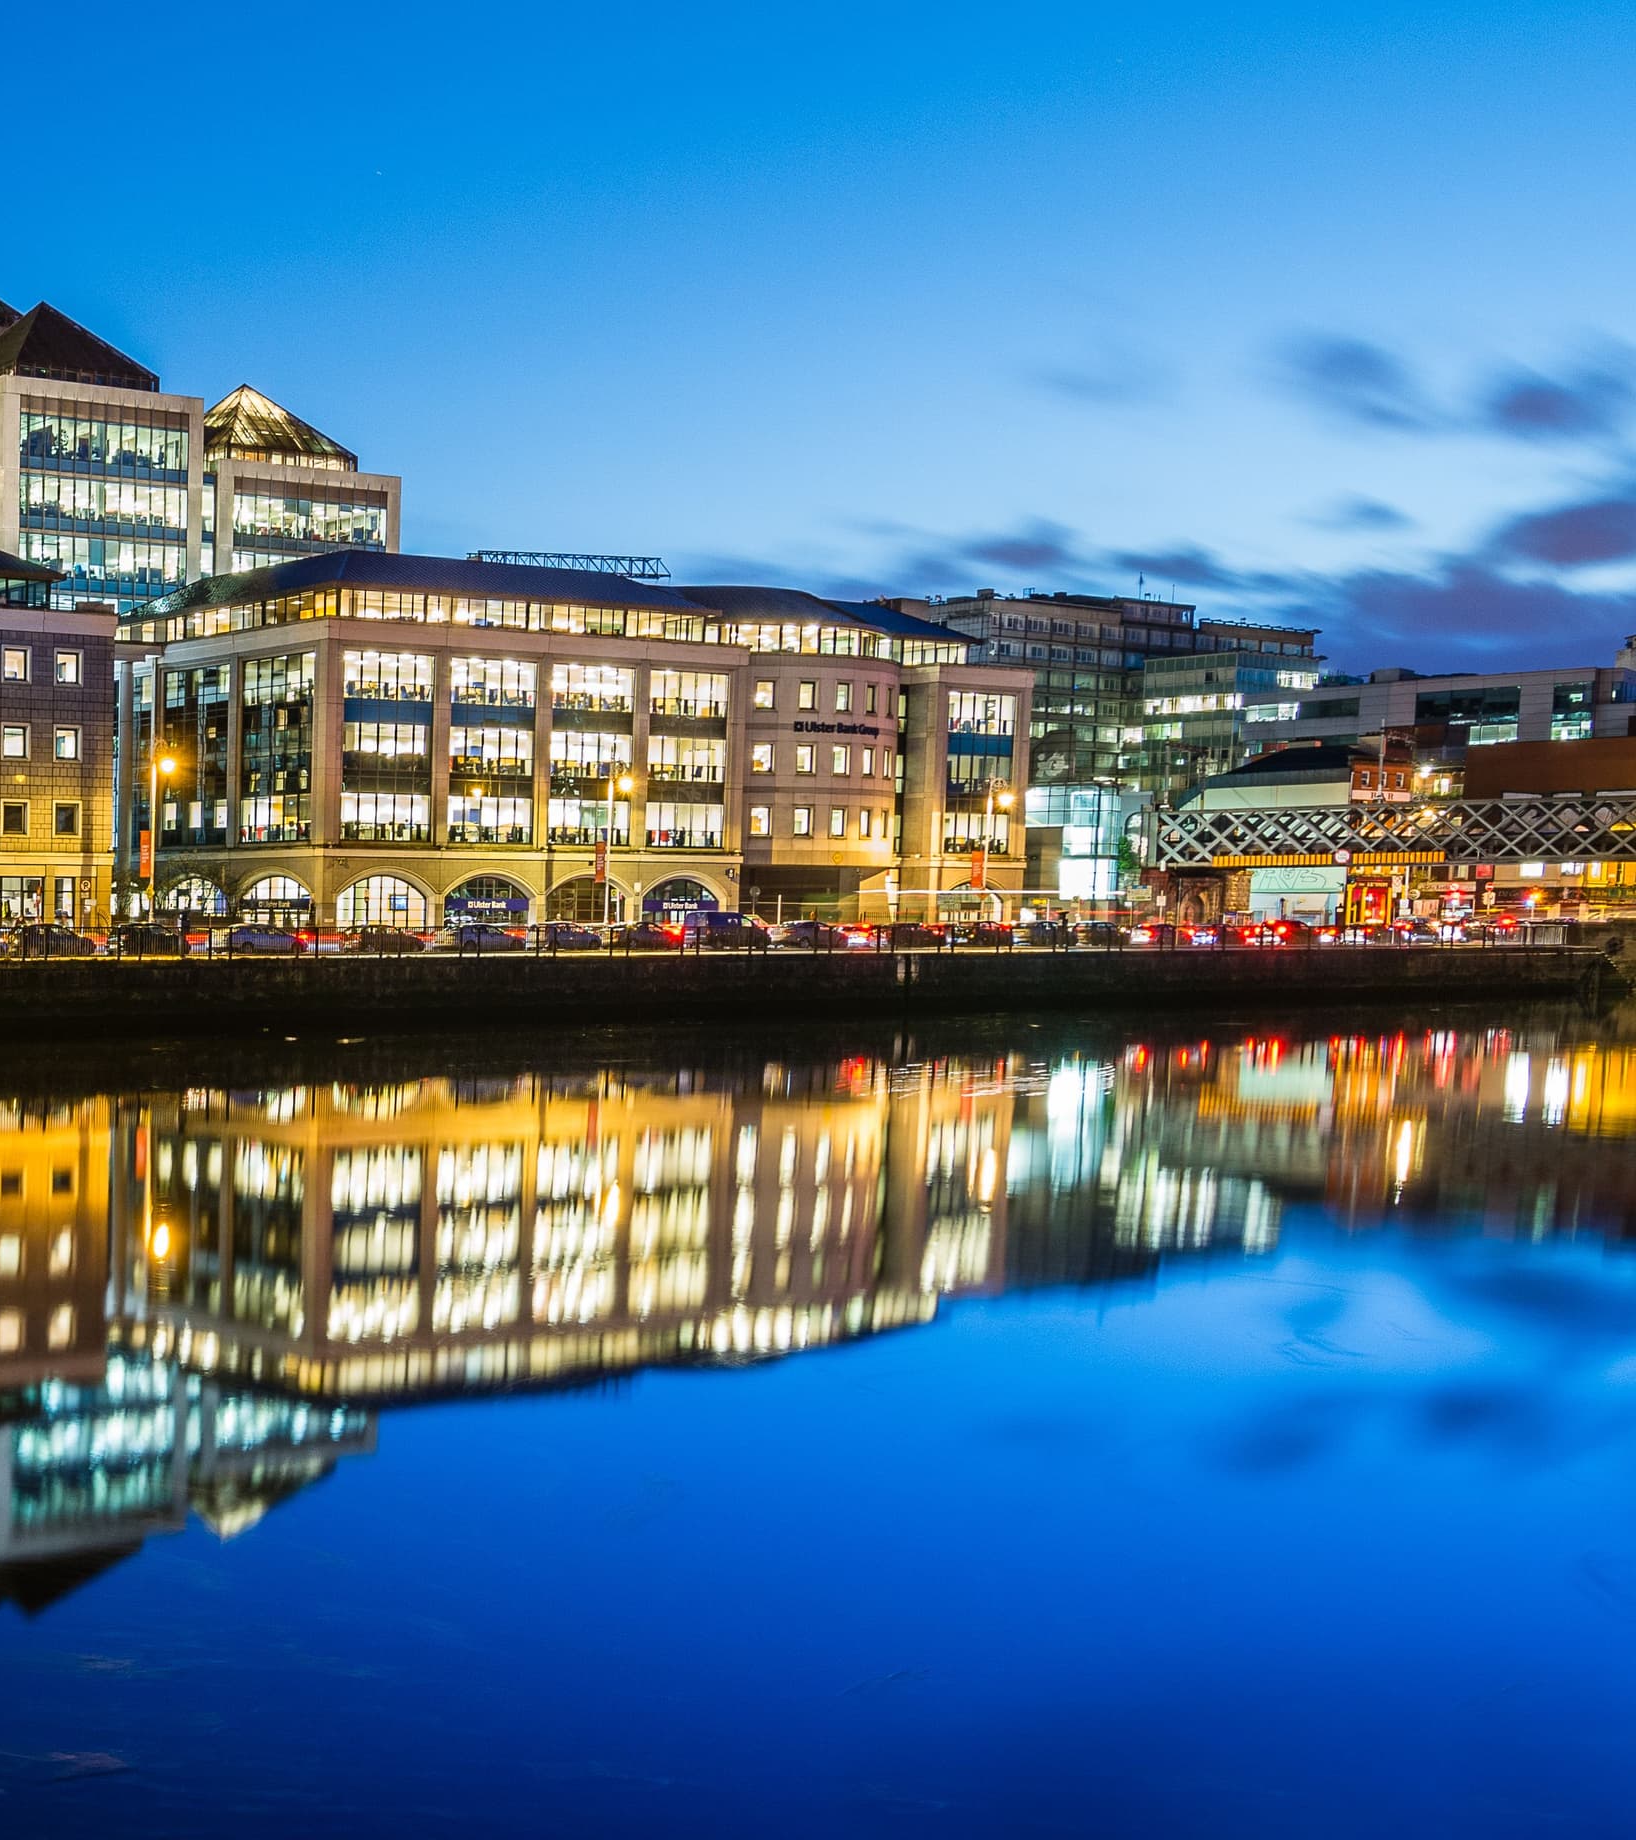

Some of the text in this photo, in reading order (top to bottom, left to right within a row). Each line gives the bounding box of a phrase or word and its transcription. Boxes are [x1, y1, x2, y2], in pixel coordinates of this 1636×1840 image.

[805, 721, 879, 739] Ulster Bank Group
[474, 901, 507, 909] Ulster Bank
